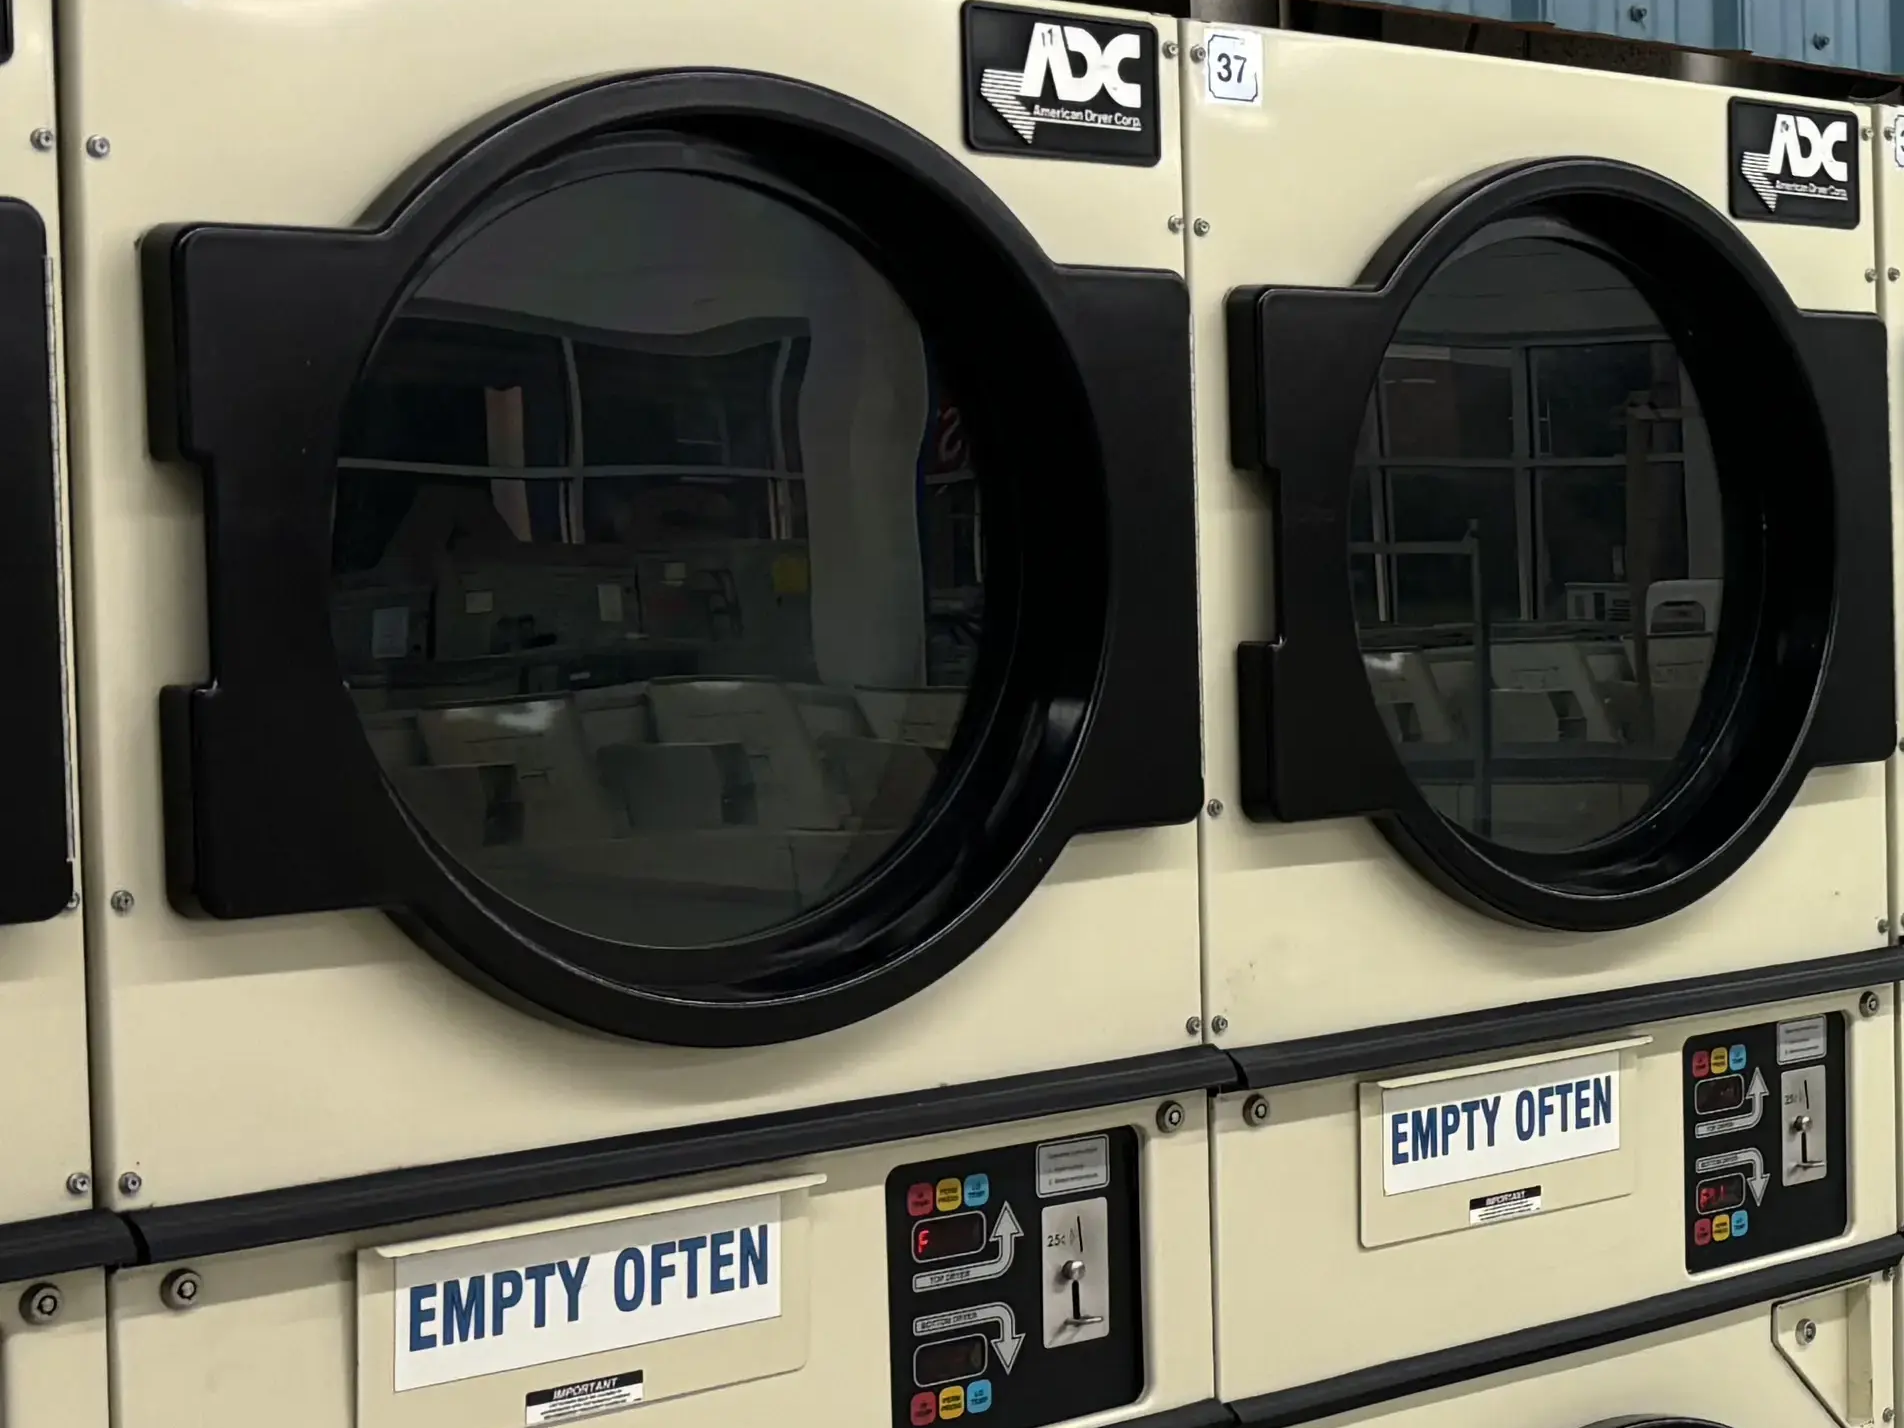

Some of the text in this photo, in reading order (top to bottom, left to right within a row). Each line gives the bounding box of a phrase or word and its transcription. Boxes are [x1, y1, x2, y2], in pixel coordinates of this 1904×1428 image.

[1015, 22, 1141, 108] ADC
[1216, 52, 1247, 84] 37
[1033, 104, 1141, 127] American Dryer Corp.
[1767, 113, 1848, 182] ADC
[1391, 1075, 1611, 1166] EMPTY OFTEN
[409, 1224, 768, 1352] EMPTY OFTEN
[553, 1377, 618, 1400] IMPORTANT
